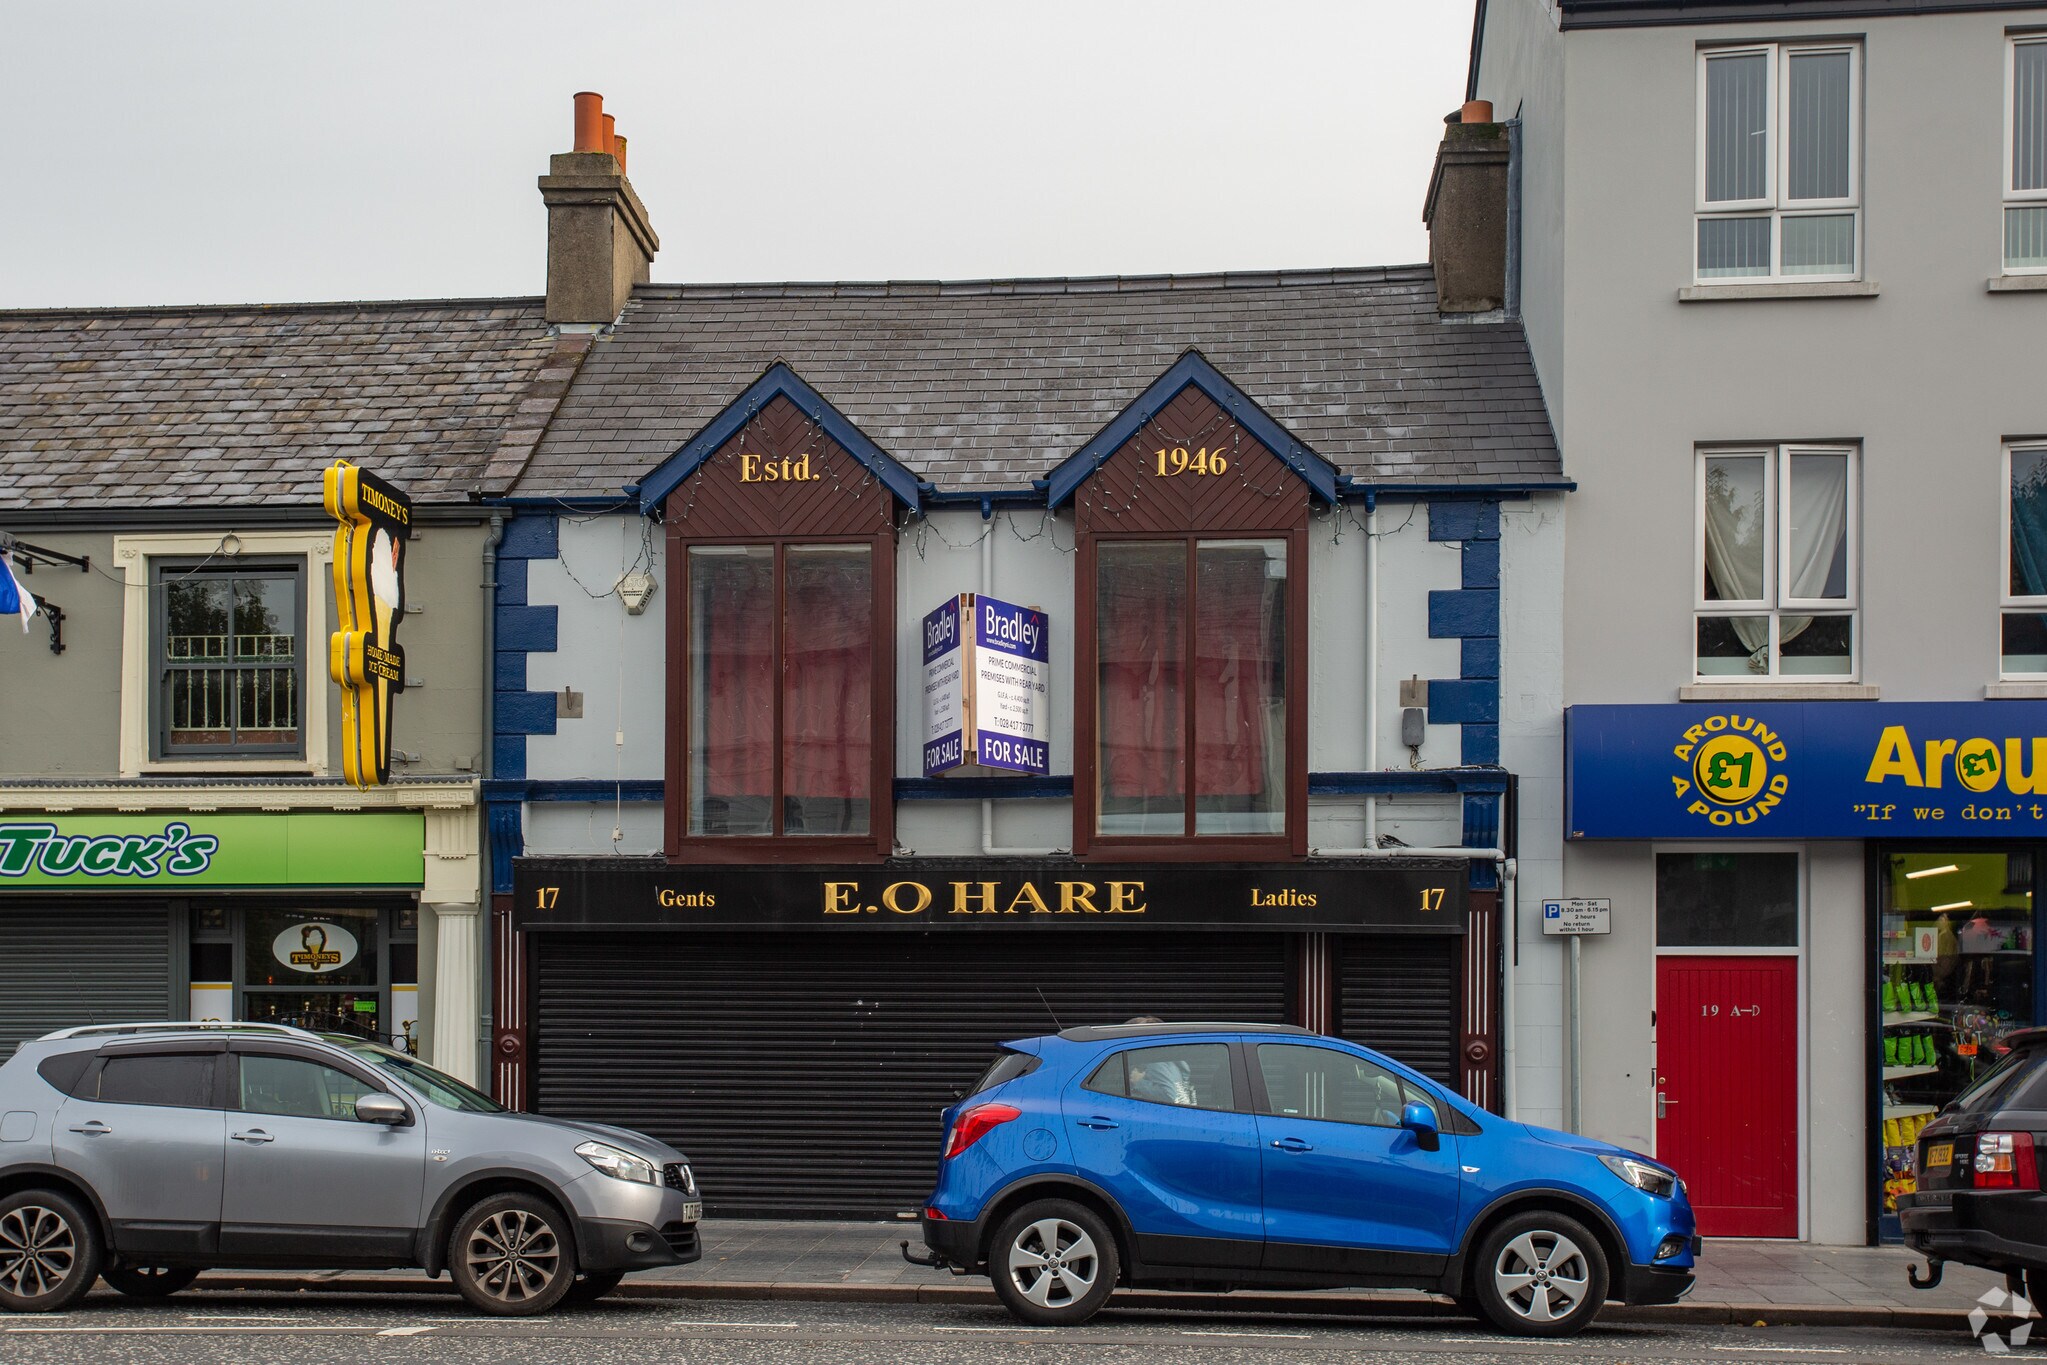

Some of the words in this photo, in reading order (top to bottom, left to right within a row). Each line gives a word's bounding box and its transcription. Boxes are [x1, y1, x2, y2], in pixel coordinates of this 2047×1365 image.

[740, 453, 820, 484] Estd.
[1154, 446, 1228, 478] 1946
[927, 609, 955, 650] Bradley
[985, 605, 1039, 654] Bradley
[368, 660, 378, 674] ICE
[378, 665, 399, 681] CREAM
[988, 656, 1005, 669] PRIME
[1004, 659, 1037, 676] COMMERCIAL
[980, 669, 1005, 684] PREMISES
[1005, 675, 1018, 687] WITH
[1019, 678, 1032, 691] REAR
[1032, 681, 1046, 693] YARD
[999, 718, 1009, 729] 028
[1673, 714, 1787, 762] AROUND
[926, 746, 940, 770] FOR
[941, 738, 959, 764] SALE
[985, 738, 1011, 763] FOR
[1014, 743, 1043, 768] SALE
[1706, 751, 1754, 789] £1
[1672, 775, 1691, 799] A
[1686, 773, 1789, 826] POUND
[1913, 807, 1945, 820] we
[535, 887, 560, 909] 17
[659, 888, 716, 907] Gents
[948, 881, 1147, 914] HARE
[1250, 888, 1317, 907] Ladies
[1419, 887, 1445, 911] 17
[1701, 1004, 1719, 1017] 19
